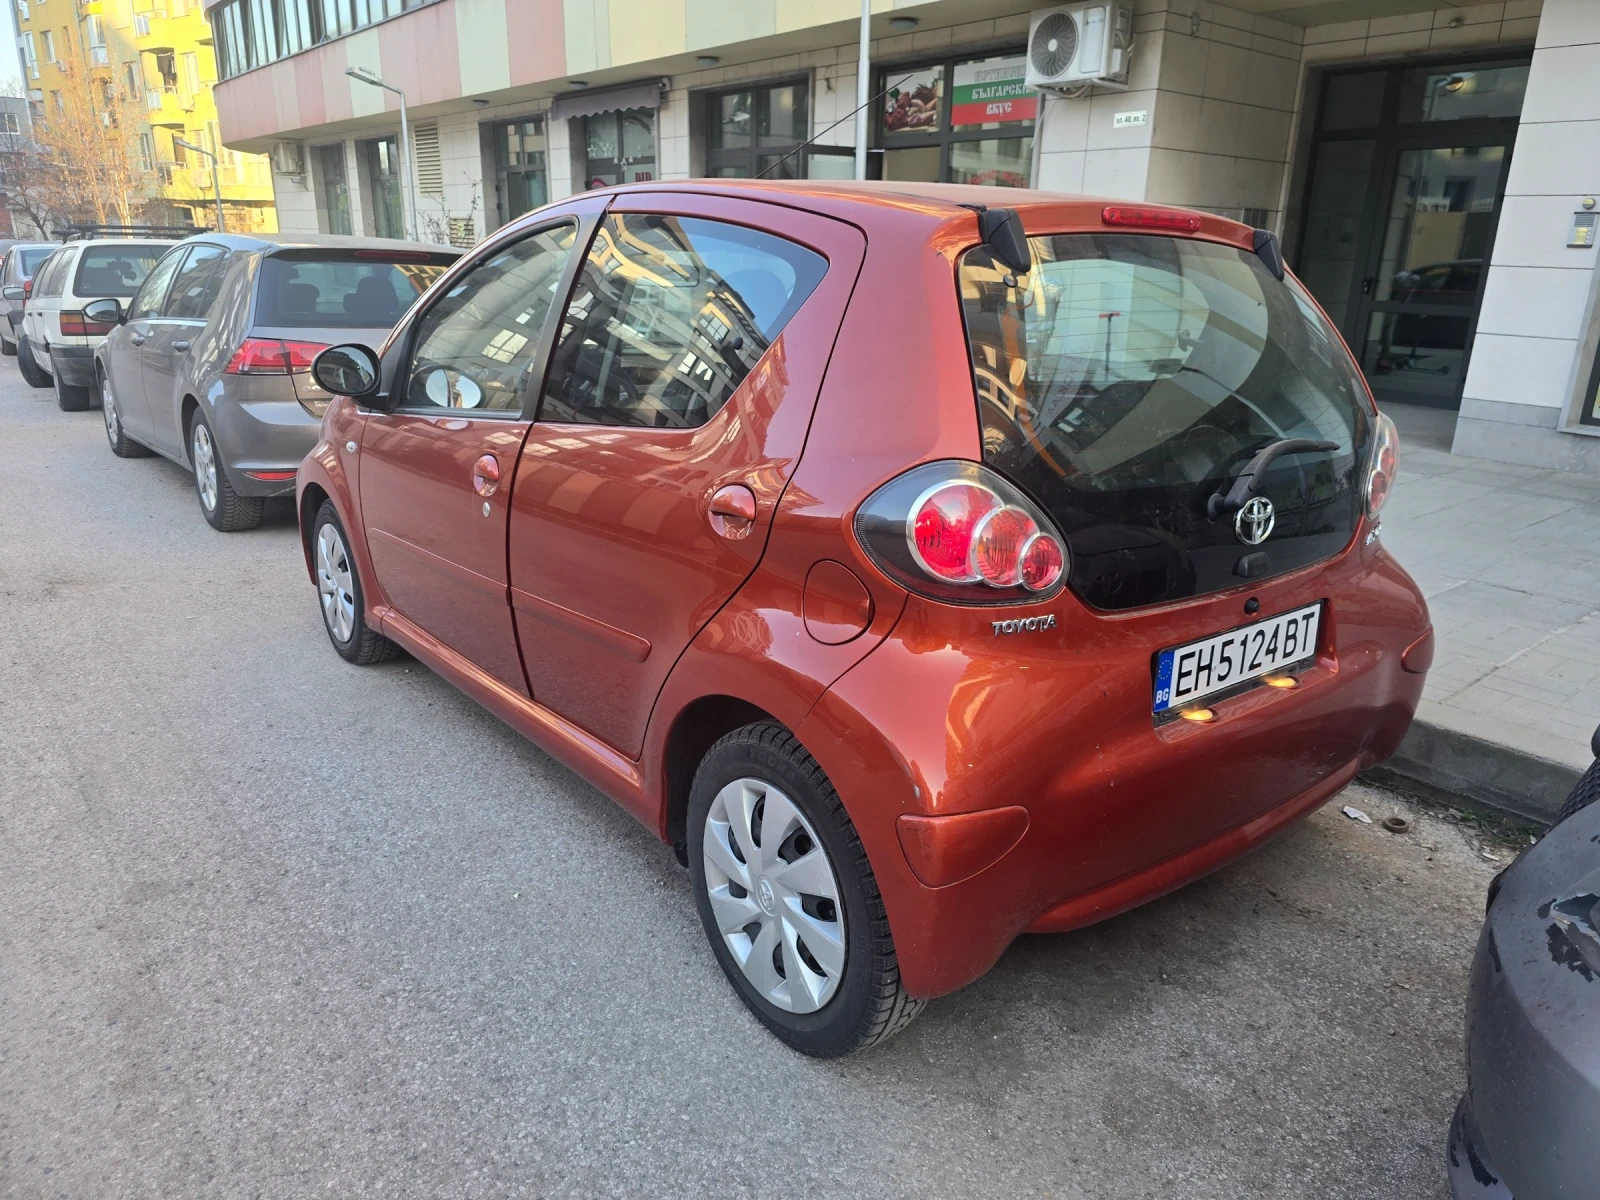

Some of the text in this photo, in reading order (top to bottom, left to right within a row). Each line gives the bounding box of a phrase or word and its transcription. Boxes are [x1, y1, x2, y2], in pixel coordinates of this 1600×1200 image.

[986, 101, 1013, 116] ВКУС
[991, 613, 1057, 637] TOYOTA
[1175, 611, 1316, 698] EH5124BT
[1155, 688, 1170, 705] BG
